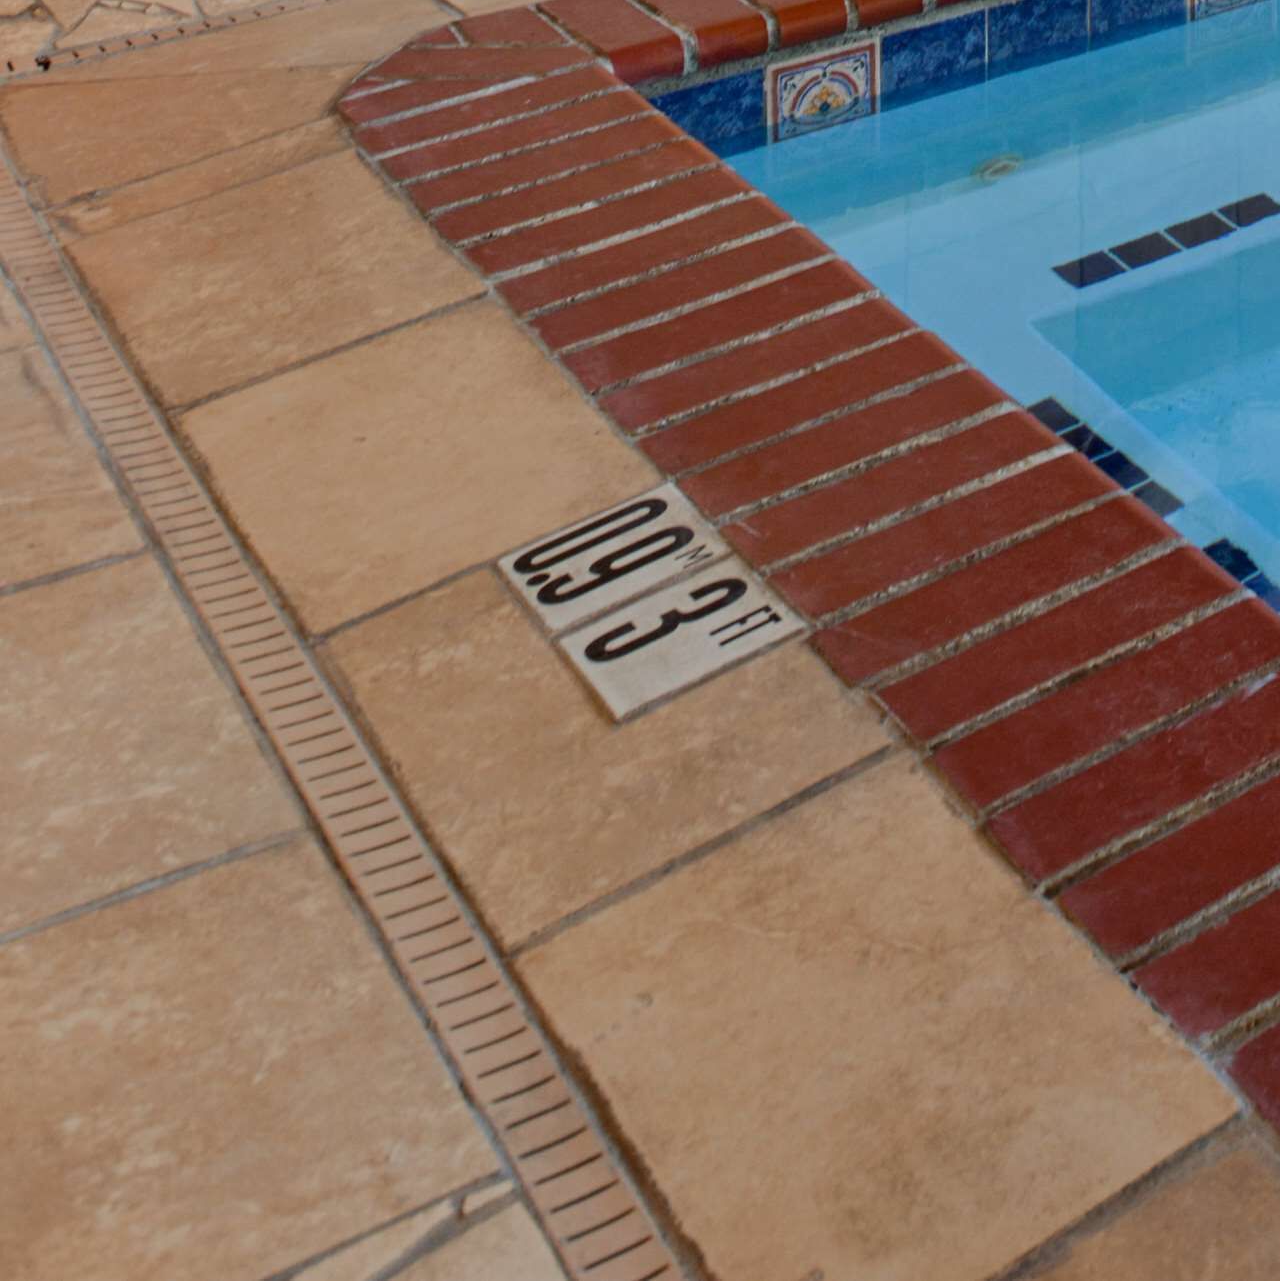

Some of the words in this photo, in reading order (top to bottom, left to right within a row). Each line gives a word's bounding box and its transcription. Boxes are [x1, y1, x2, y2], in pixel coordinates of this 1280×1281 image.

[513, 498, 695, 605] 0.9
[674, 544, 713, 569] M
[584, 578, 748, 662] 3
[709, 605, 782, 647] FT
